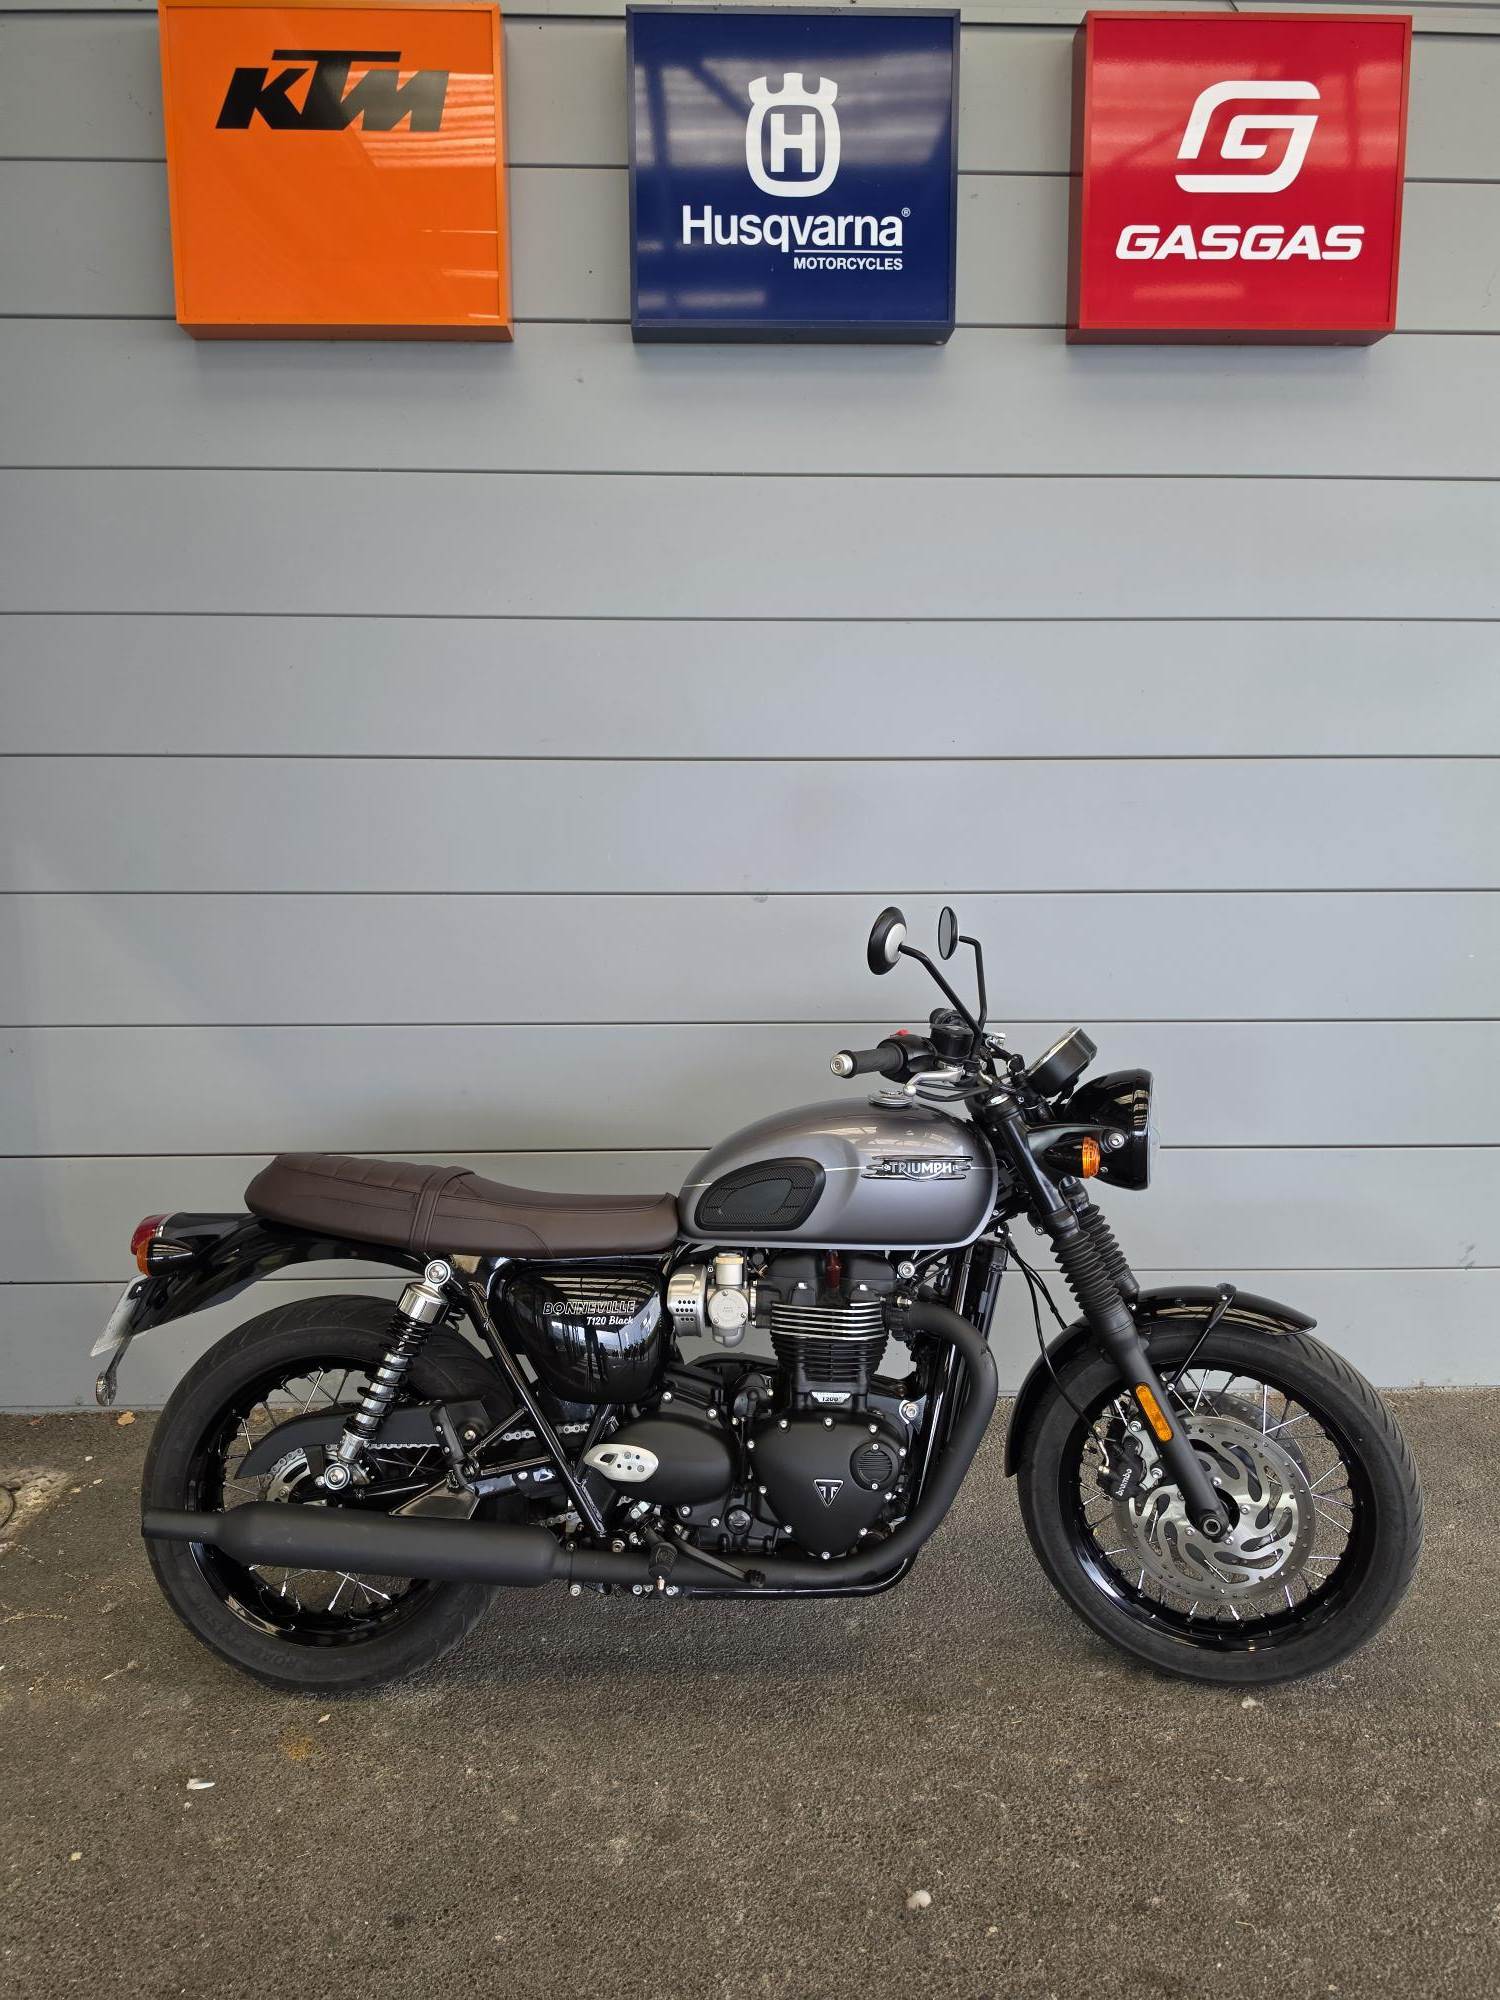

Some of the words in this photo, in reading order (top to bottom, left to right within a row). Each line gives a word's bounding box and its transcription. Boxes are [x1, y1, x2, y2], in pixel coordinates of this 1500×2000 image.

[215, 49, 450, 132] KTM
[1115, 224, 1365, 261] GASGAS
[793, 257, 903, 270] MOTORCYCLES
[889, 1162, 952, 1174] TRIUMPH
[543, 1300, 635, 1315] BONNEVILLE
[586, 1316, 607, 1326] T120
[608, 1315, 634, 1325] Black
[1115, 1468, 1132, 1497] brembo
